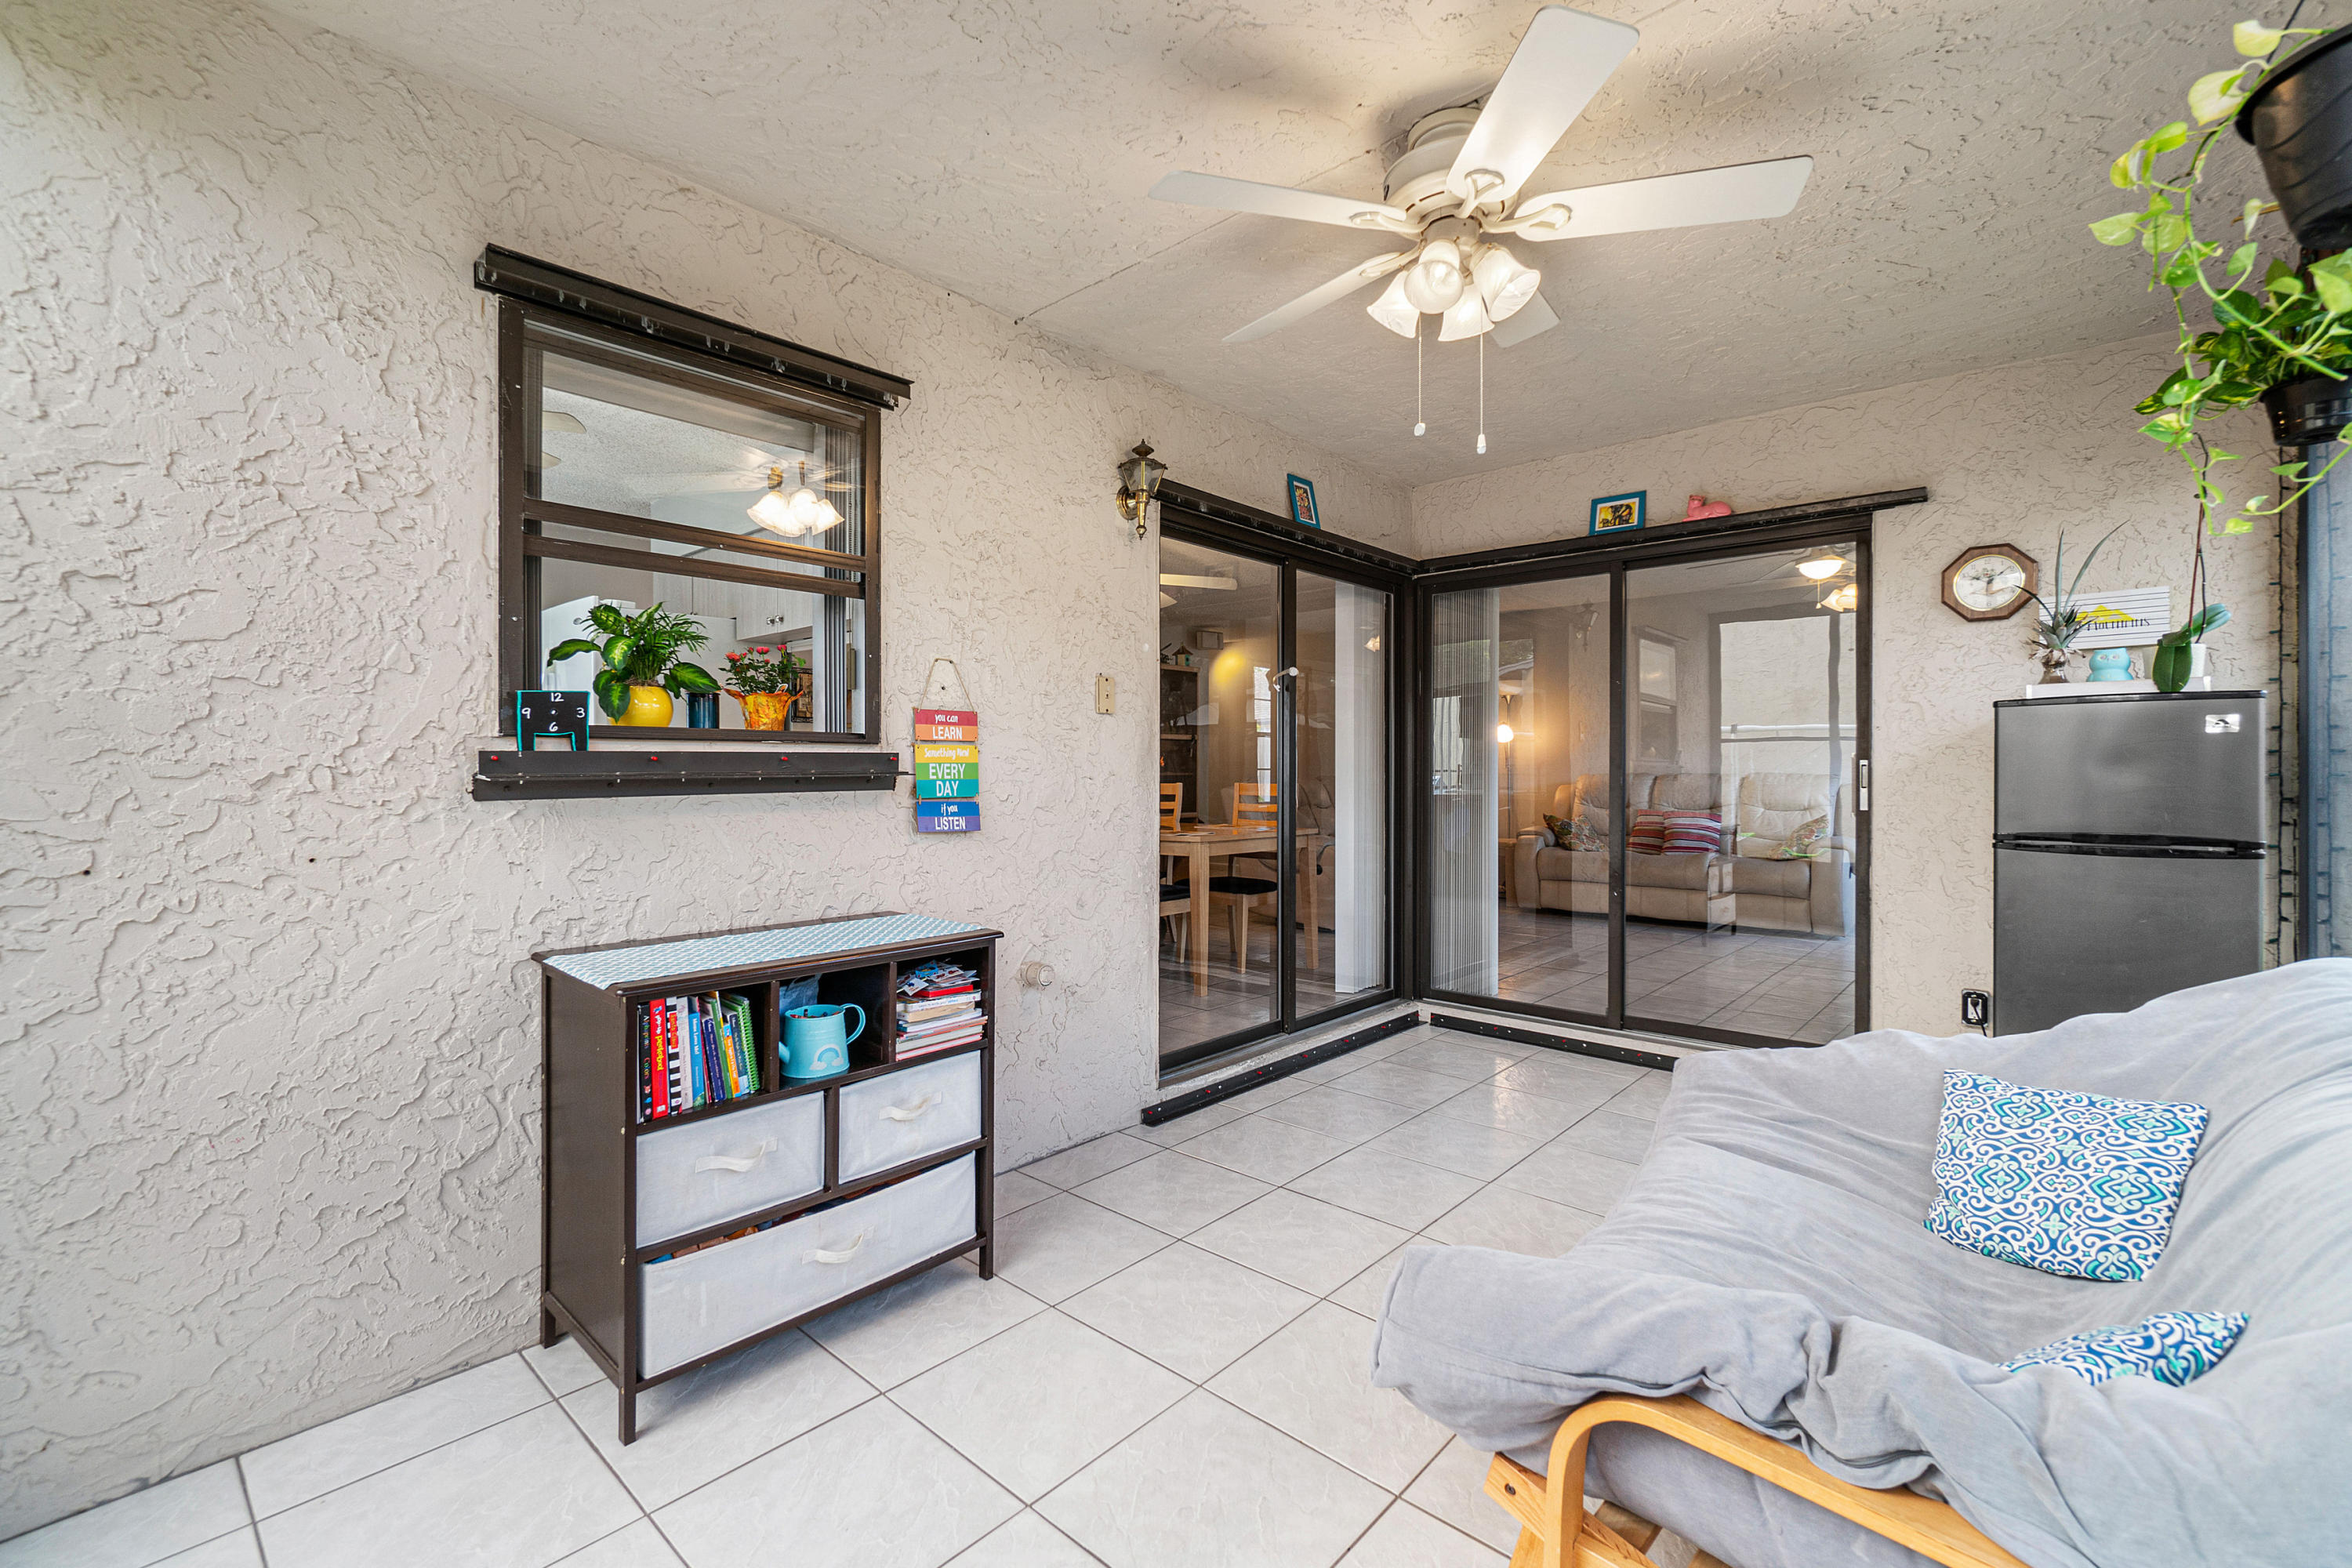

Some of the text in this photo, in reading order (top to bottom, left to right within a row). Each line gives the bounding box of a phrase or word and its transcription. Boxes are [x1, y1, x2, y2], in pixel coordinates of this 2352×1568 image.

[550, 692, 564, 702] 12
[521, 707, 531, 719] 9
[576, 707, 586, 718] 3
[935, 713, 958, 724] you can
[549, 722, 558, 732] 6
[932, 726, 963, 740] LEARN
[929, 763, 966, 779] EVERY
[935, 780, 959, 797] DAY
[941, 804, 958, 815] if you
[935, 816, 966, 830] LISTEN
